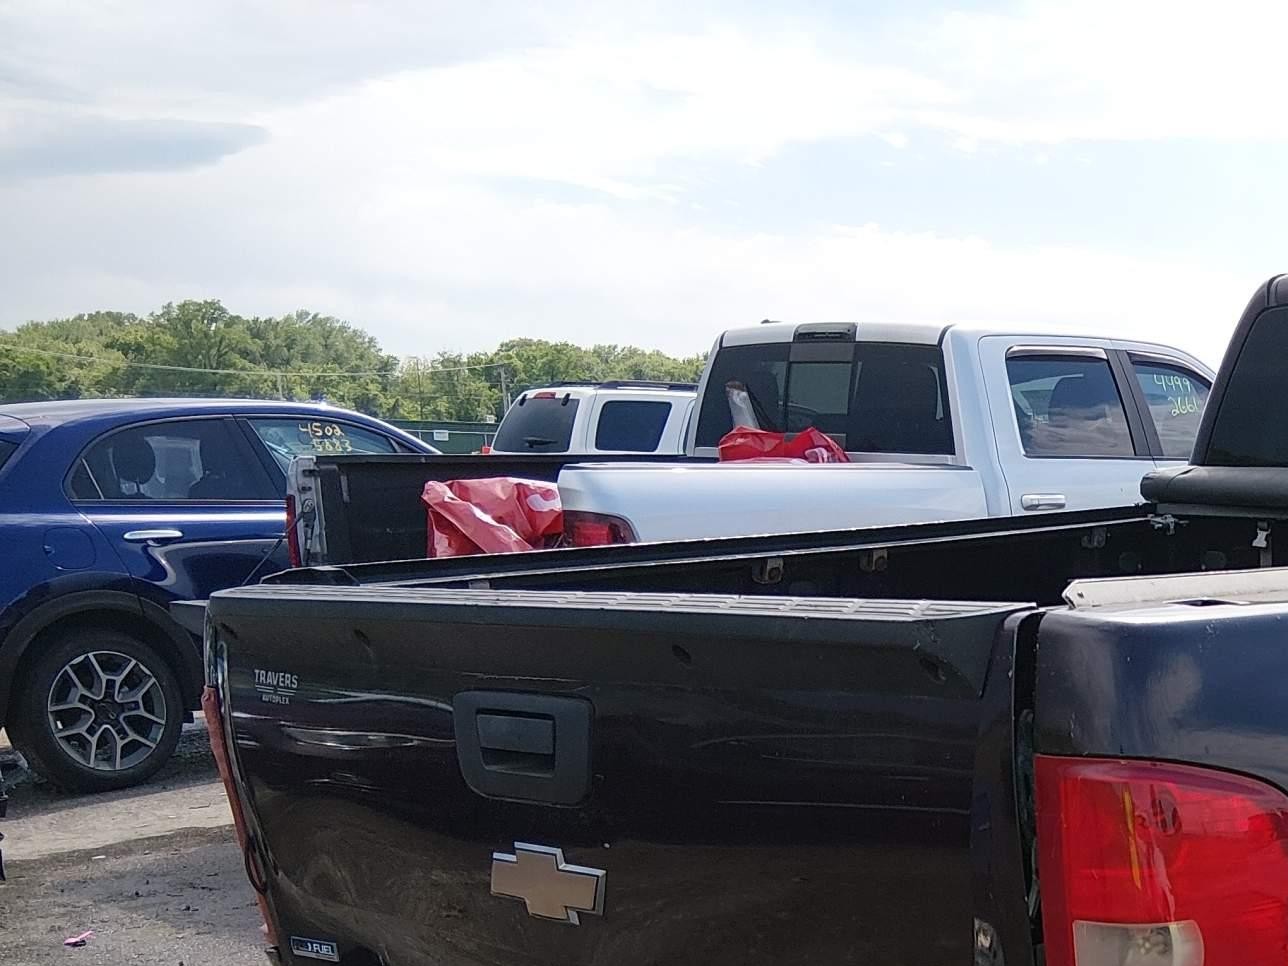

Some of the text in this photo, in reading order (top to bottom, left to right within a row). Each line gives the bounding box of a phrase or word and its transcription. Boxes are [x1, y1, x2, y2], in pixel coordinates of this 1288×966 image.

[1153, 374, 1191, 393] 4499
[298, 422, 345, 438] 4502
[254, 669, 298, 689] TRAVERS
